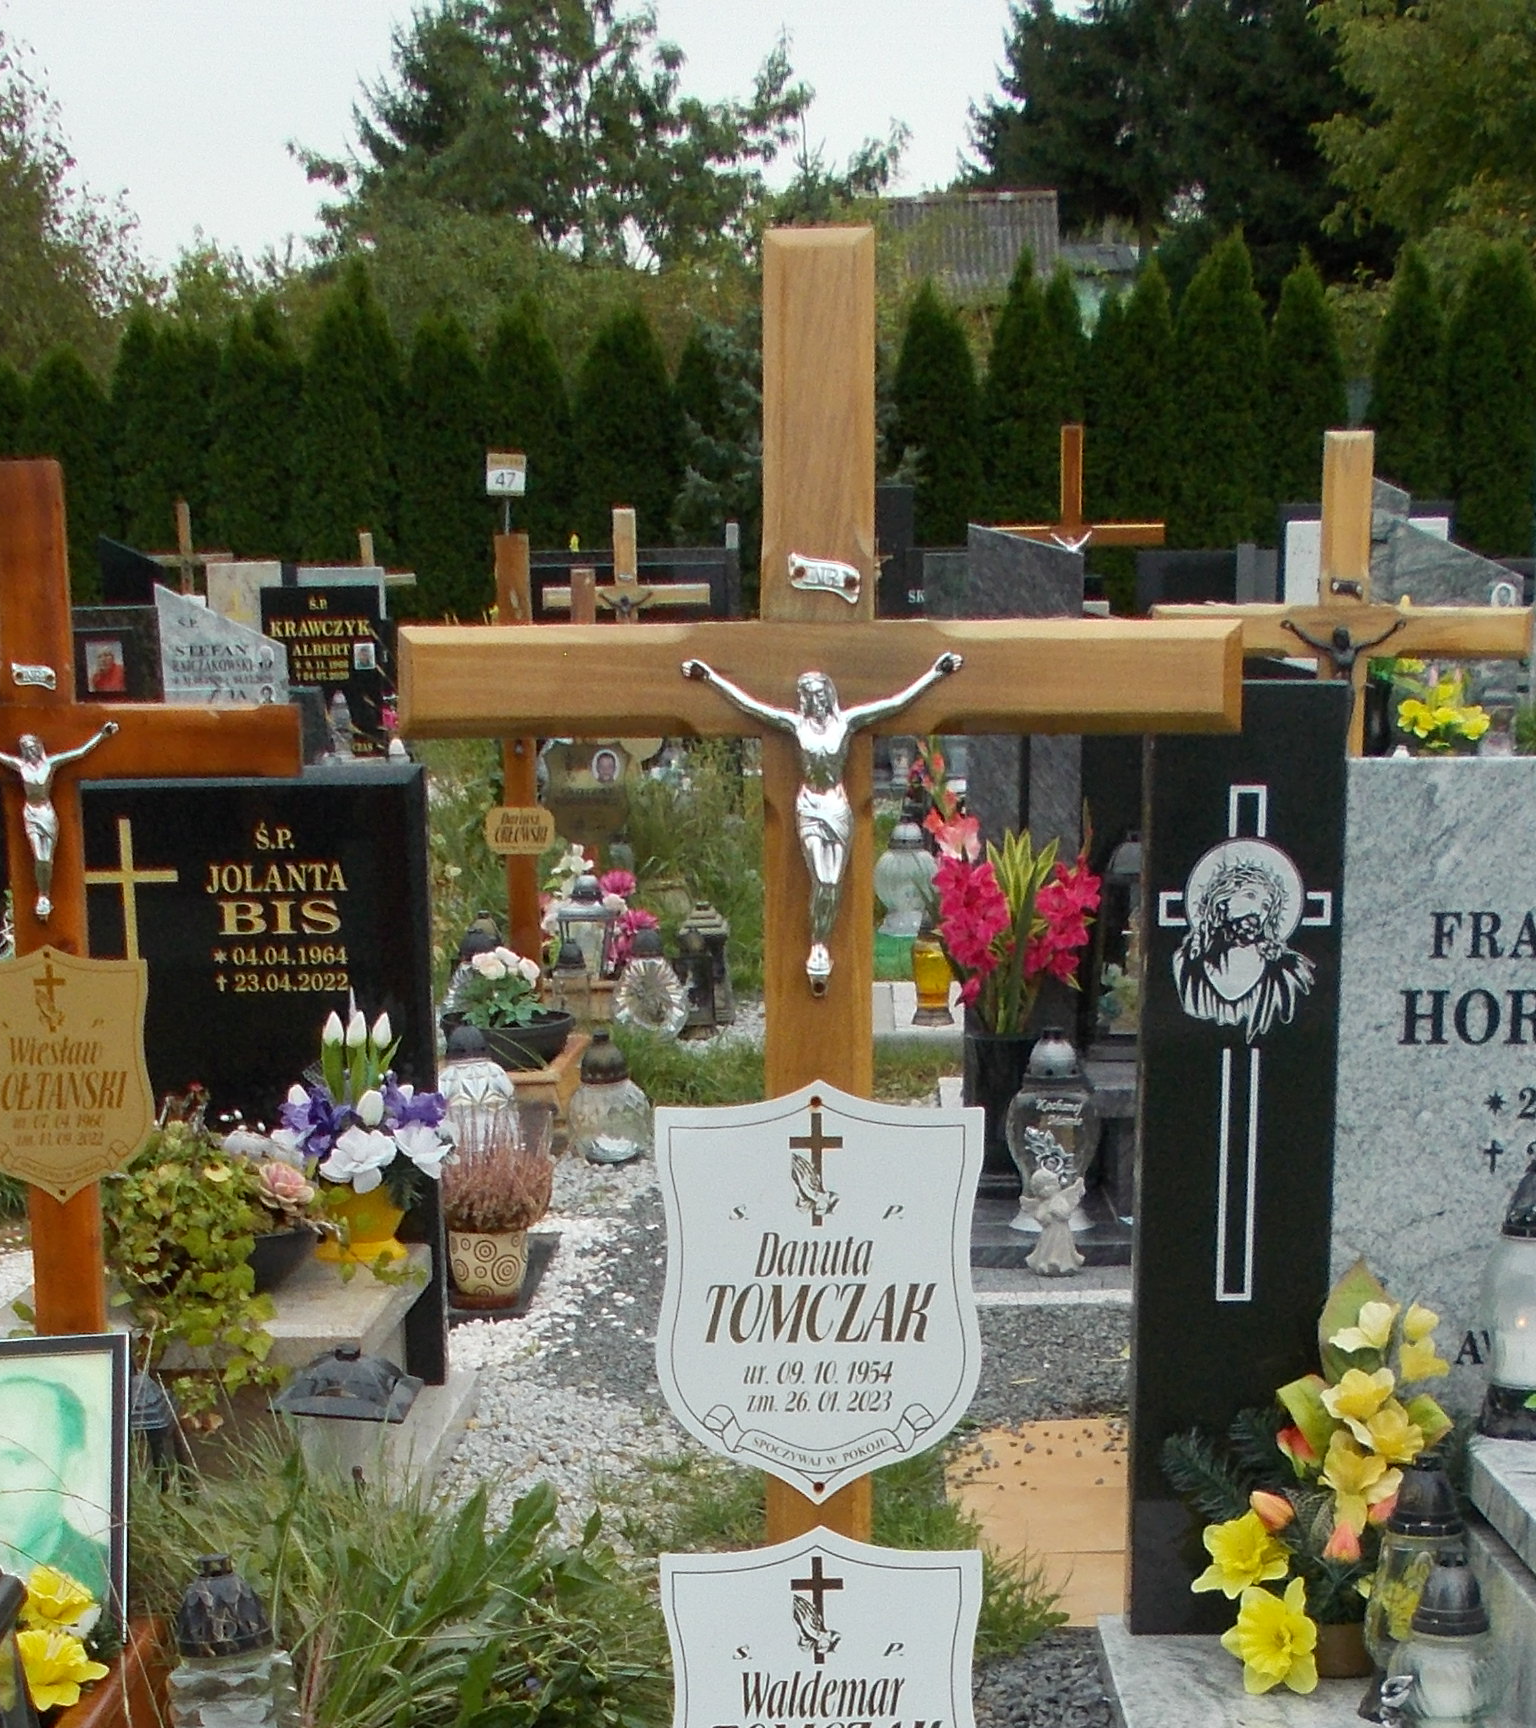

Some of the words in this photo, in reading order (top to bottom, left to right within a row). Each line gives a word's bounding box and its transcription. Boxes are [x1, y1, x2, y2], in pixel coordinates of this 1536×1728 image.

[495, 472, 515, 488] 47
[270, 619, 371, 638] KRAWCZYK
[175, 644, 250, 657] STEFAN
[292, 642, 351, 657] ALBERT
[255, 820, 296, 850] Ś.P.
[206, 863, 349, 894] JOLANTA
[218, 899, 342, 936] BIS
[231, 945, 349, 966] 04.04.1964
[233, 973, 350, 993] 23.04.2022
[754, 1231, 874, 1279] Danuta
[705, 1281, 937, 1345] TOMCZAK
[742, 1364, 770, 1386] ur.
[776, 1360, 806, 1386] 09.
[814, 1360, 839, 1386] 10.
[846, 1360, 895, 1385] 1954
[747, 1394, 779, 1413] zm.
[783, 1390, 811, 1413] 26.
[817, 1390, 841, 1413] 01.
[846, 1389, 894, 1412] 2023
[751, 1436, 822, 1467] SPOCZYWAJ
[826, 1456, 839, 1466] W
[842, 1435, 890, 1464] POKOJU
[740, 1669, 906, 1720] Waldemar
